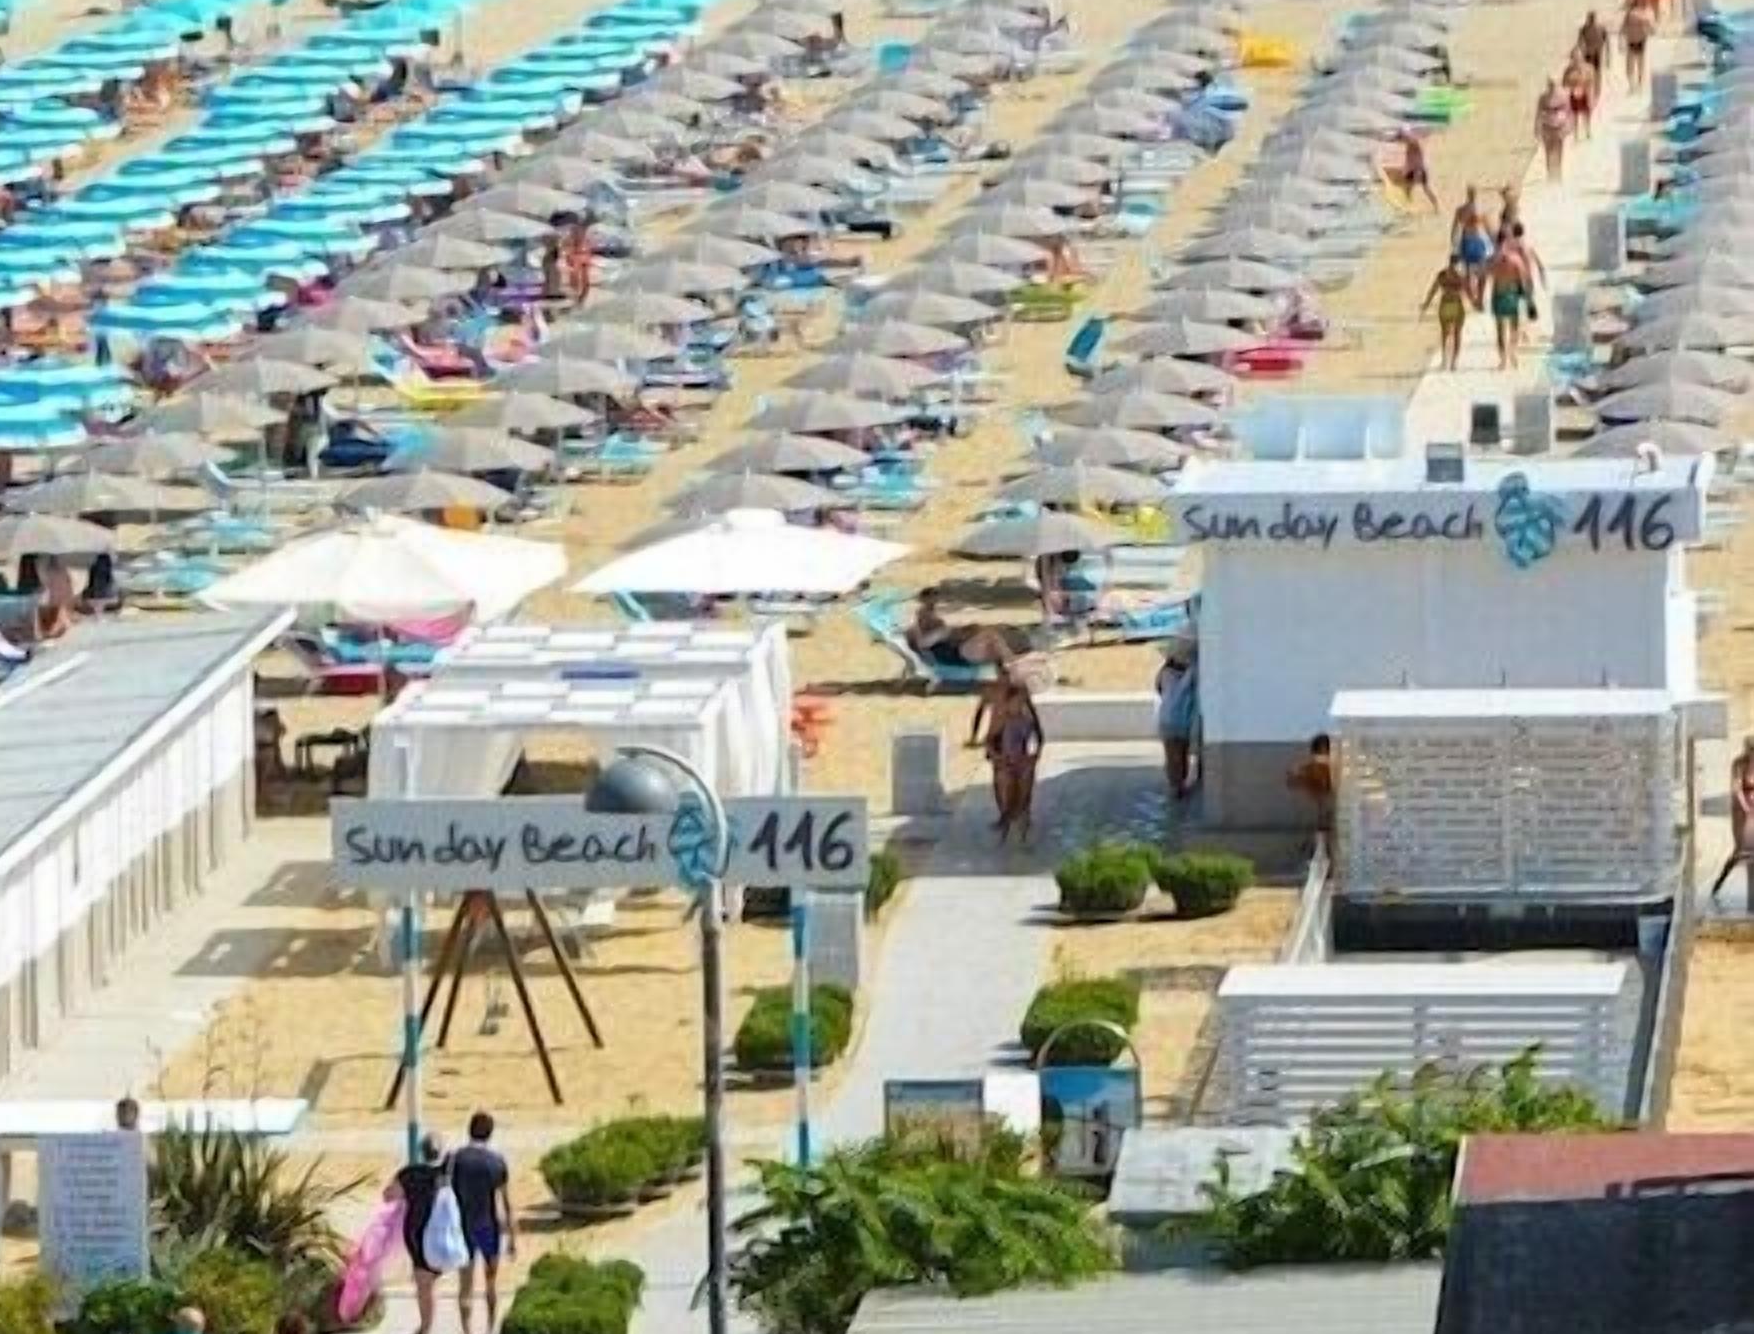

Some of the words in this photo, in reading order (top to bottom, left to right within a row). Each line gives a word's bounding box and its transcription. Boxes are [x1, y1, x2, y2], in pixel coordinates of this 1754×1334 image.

[1182, 502, 1339, 550] Sunday
[1353, 501, 1483, 542] Beach
[1573, 493, 1676, 551] 116
[345, 821, 503, 873] Sunday
[522, 817, 656, 865] Beach
[750, 810, 855, 871] 116
